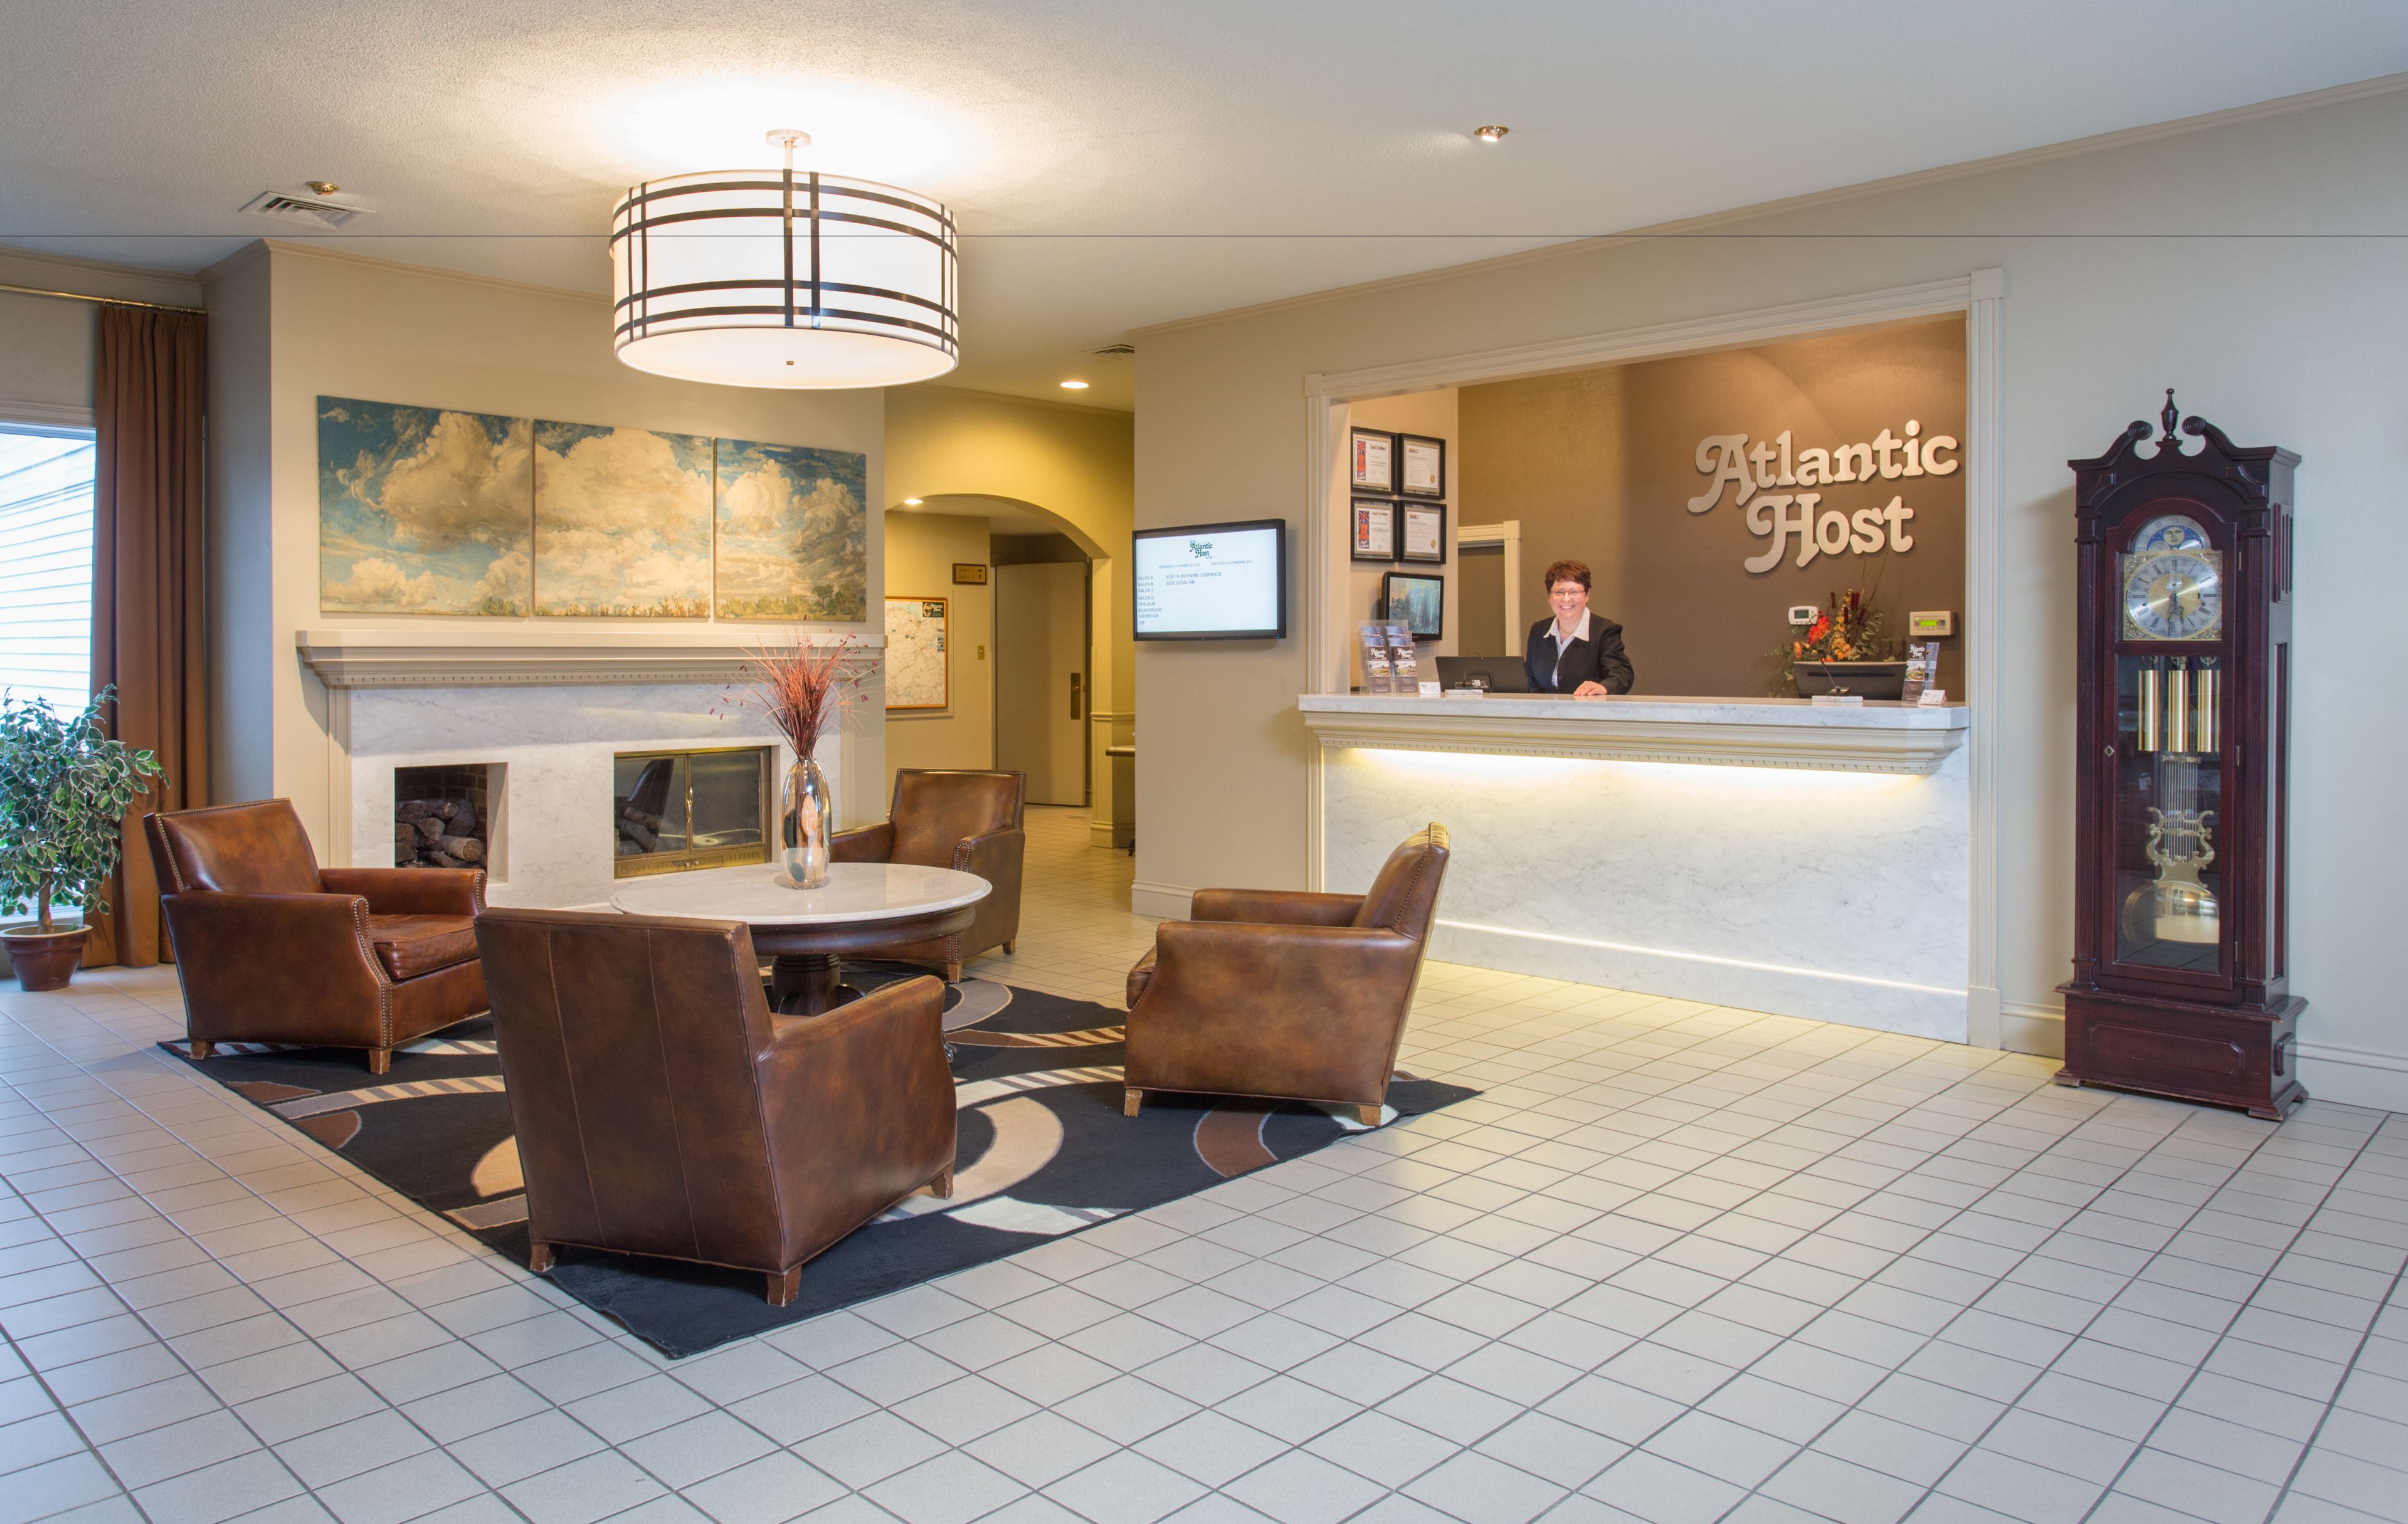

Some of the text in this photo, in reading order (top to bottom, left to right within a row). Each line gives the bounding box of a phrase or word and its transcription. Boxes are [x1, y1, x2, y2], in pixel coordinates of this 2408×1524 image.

[1687, 419, 1958, 513] Atlantic
[1189, 542, 1213, 552] Atlantic
[1195, 549, 1210, 558] Host
[1744, 493, 1914, 574] Host
